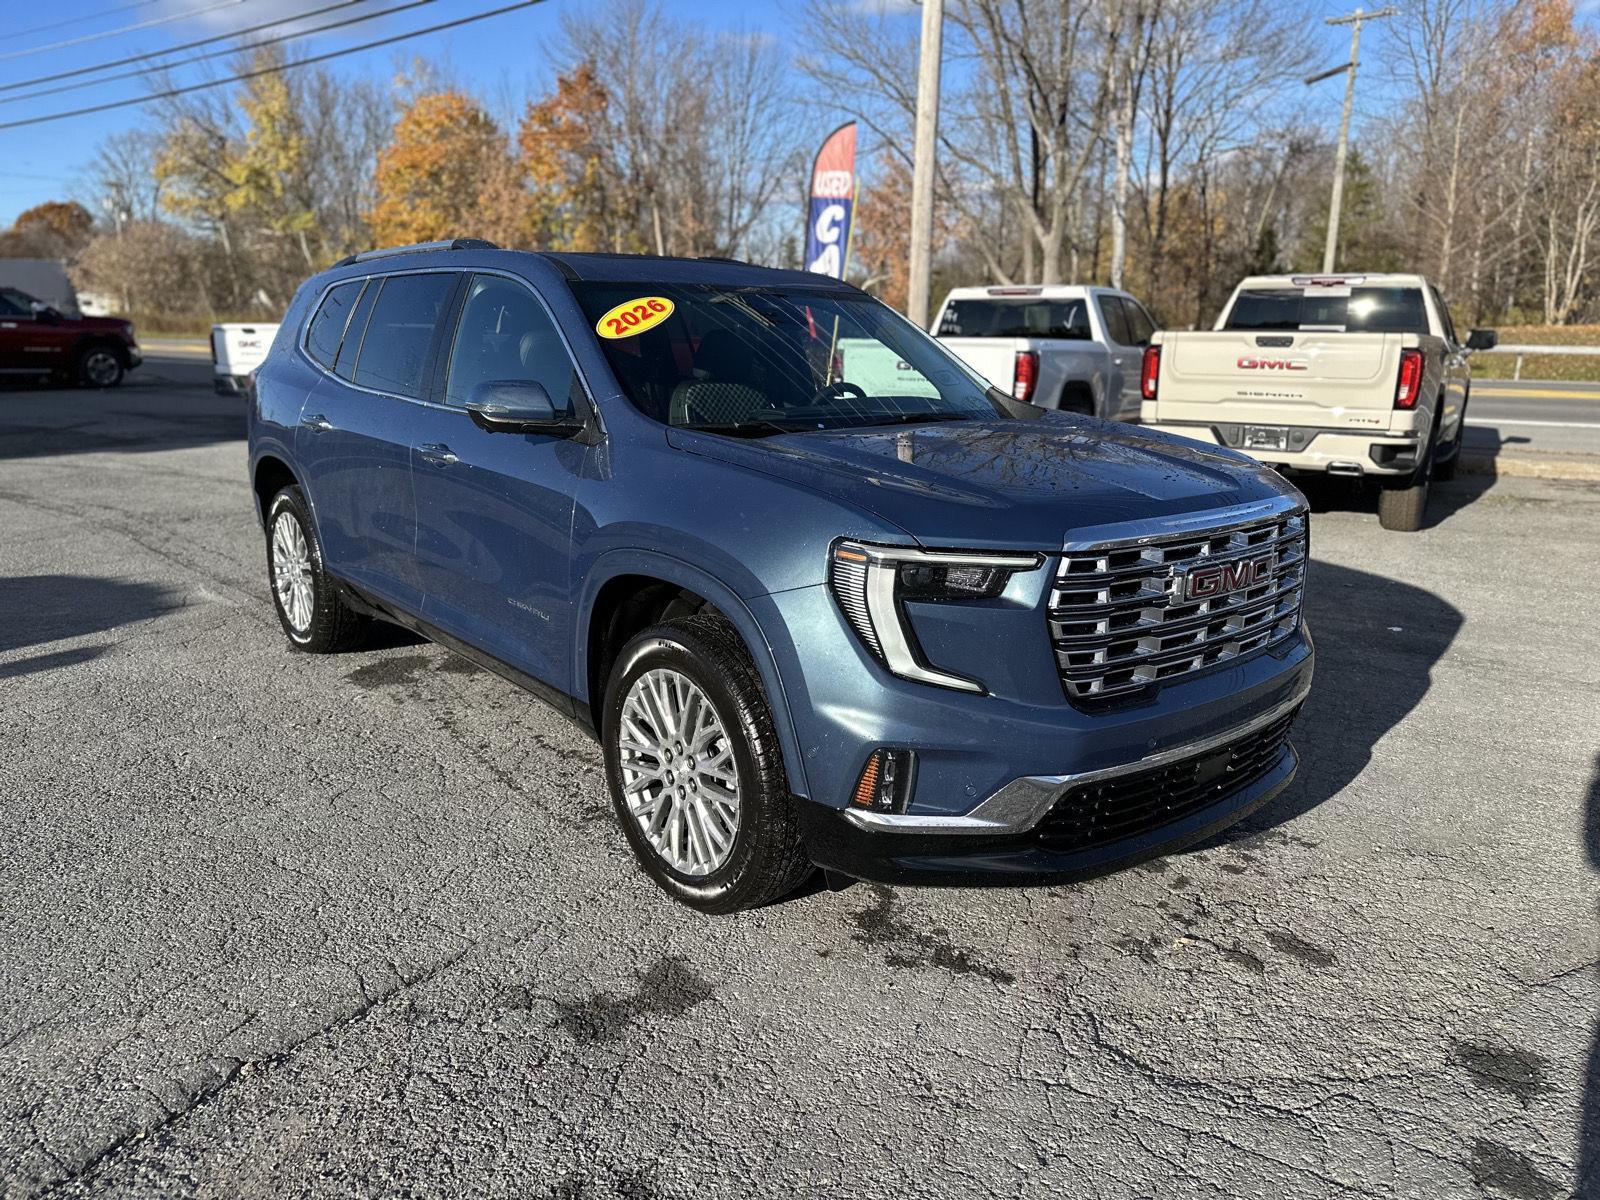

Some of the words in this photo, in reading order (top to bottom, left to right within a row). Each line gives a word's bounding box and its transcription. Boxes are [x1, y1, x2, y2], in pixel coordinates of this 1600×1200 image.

[815, 170, 851, 196] USED
[607, 300, 666, 335] 2026
[1237, 357, 1308, 370] GMC
[1190, 552, 1279, 598] GMC
